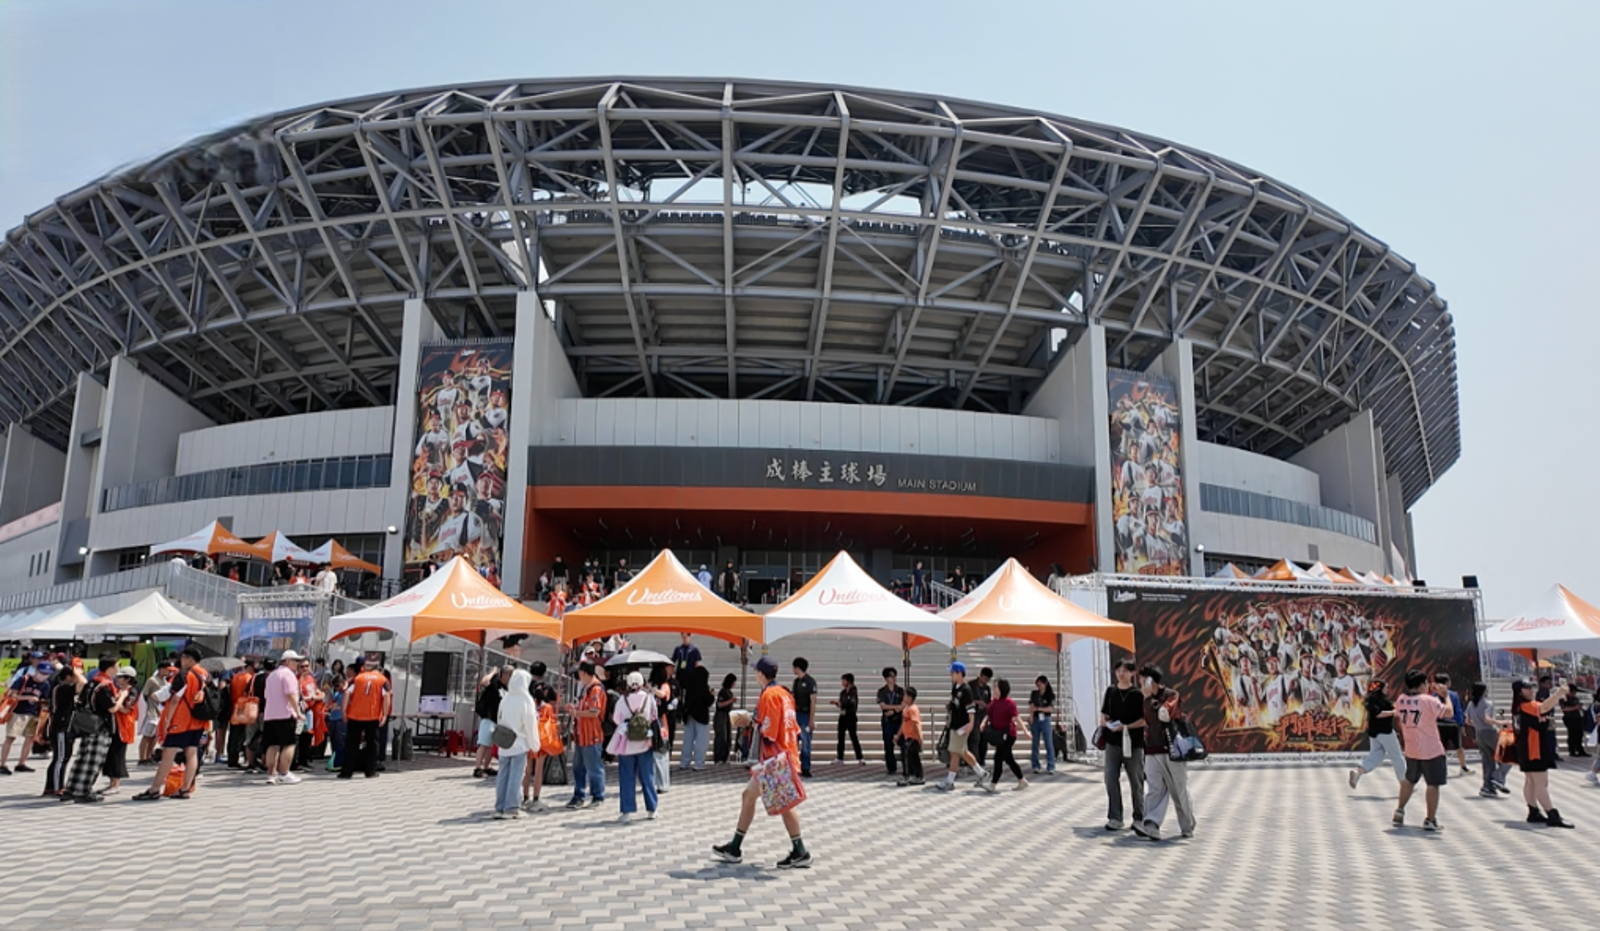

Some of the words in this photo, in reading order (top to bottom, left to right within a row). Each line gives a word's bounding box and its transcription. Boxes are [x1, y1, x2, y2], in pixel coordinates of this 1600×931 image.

[765, 457, 887, 487] 成棒主球場
[898, 478, 925, 489] MAIN
[929, 479, 977, 492] STADIUM
[1399, 708, 1420, 726] 77
